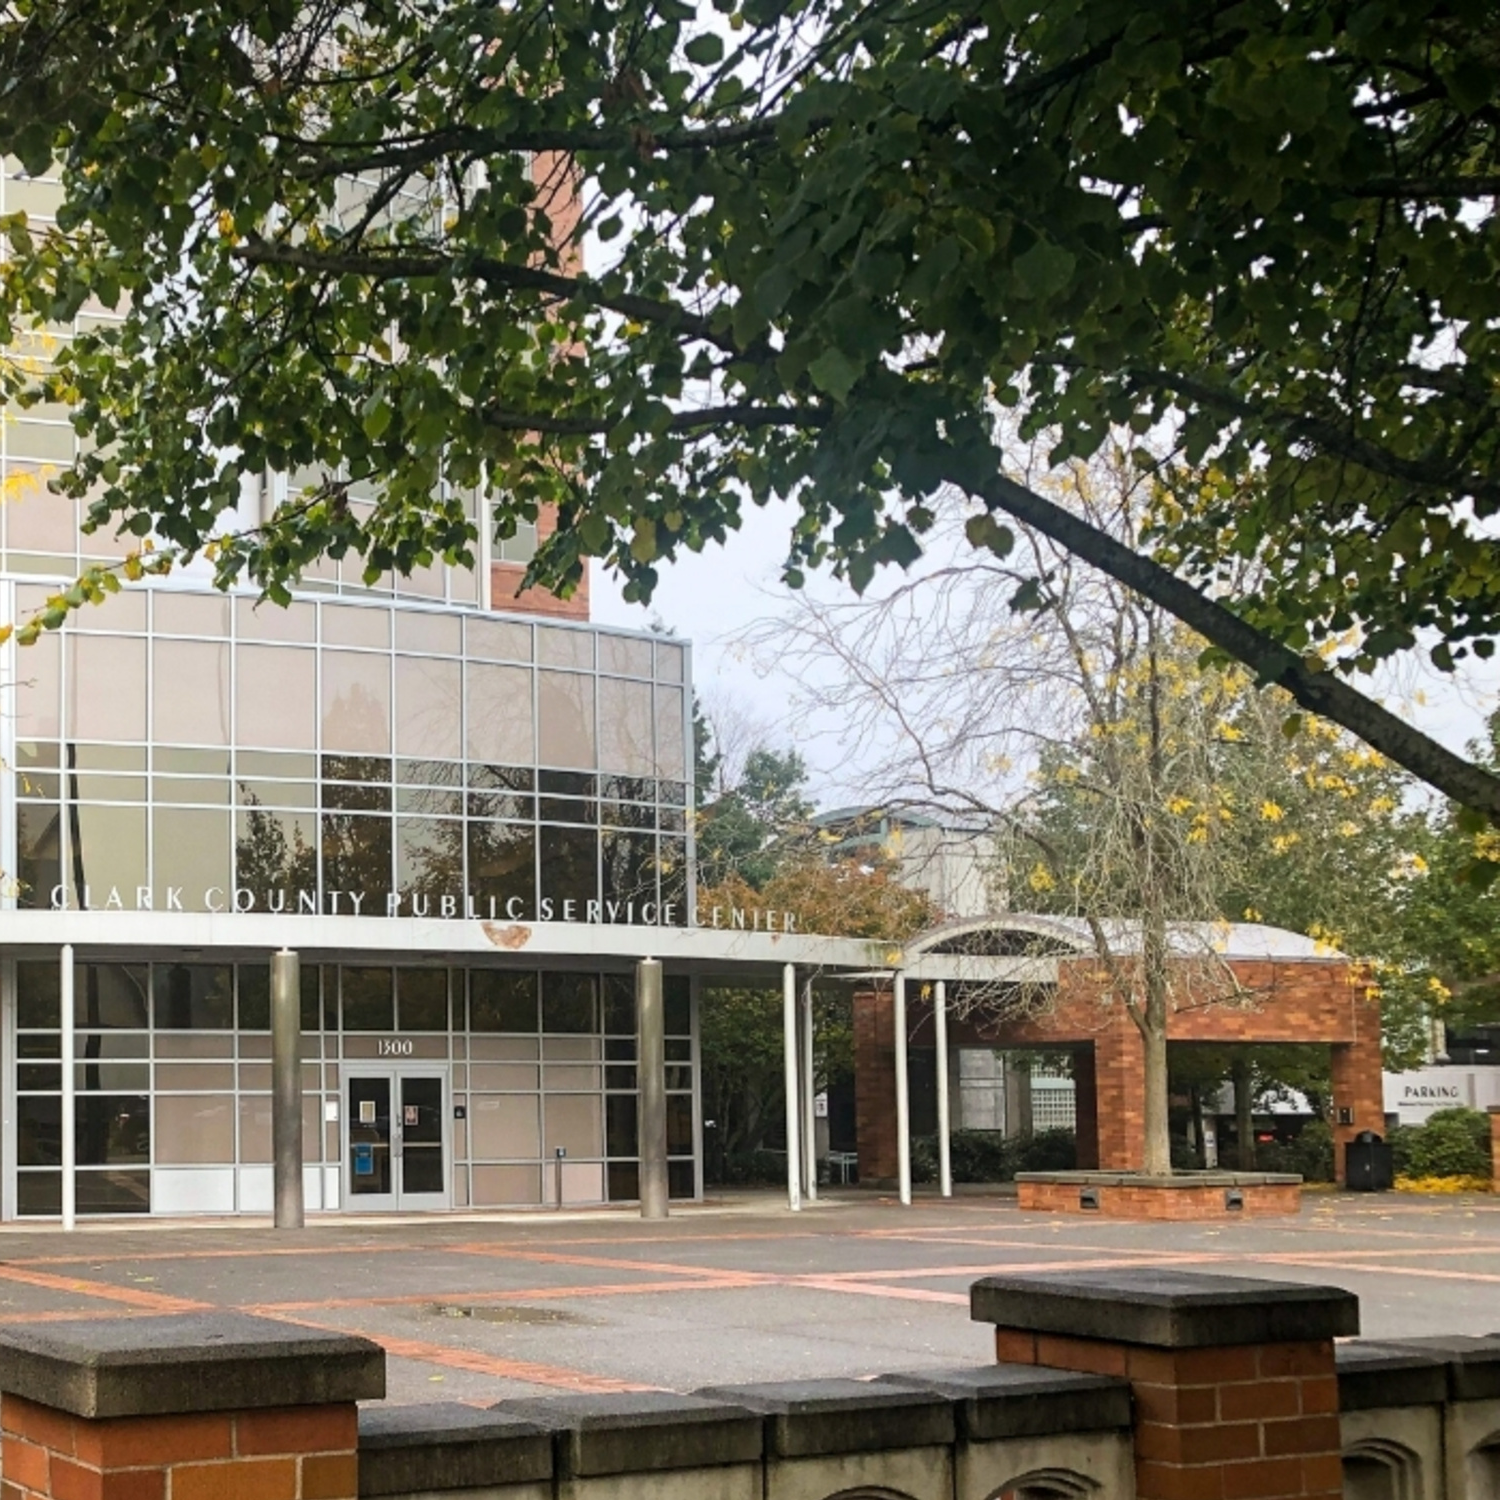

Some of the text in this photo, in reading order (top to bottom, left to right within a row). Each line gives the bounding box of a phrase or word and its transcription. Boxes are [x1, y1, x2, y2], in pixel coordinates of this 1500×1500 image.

[49, 884, 798, 932] CLARK COUNTY PUBLIC SERVICE CENTER
[378, 1038, 413, 1056] 1300
[1404, 1085, 1459, 1098] PARKING
